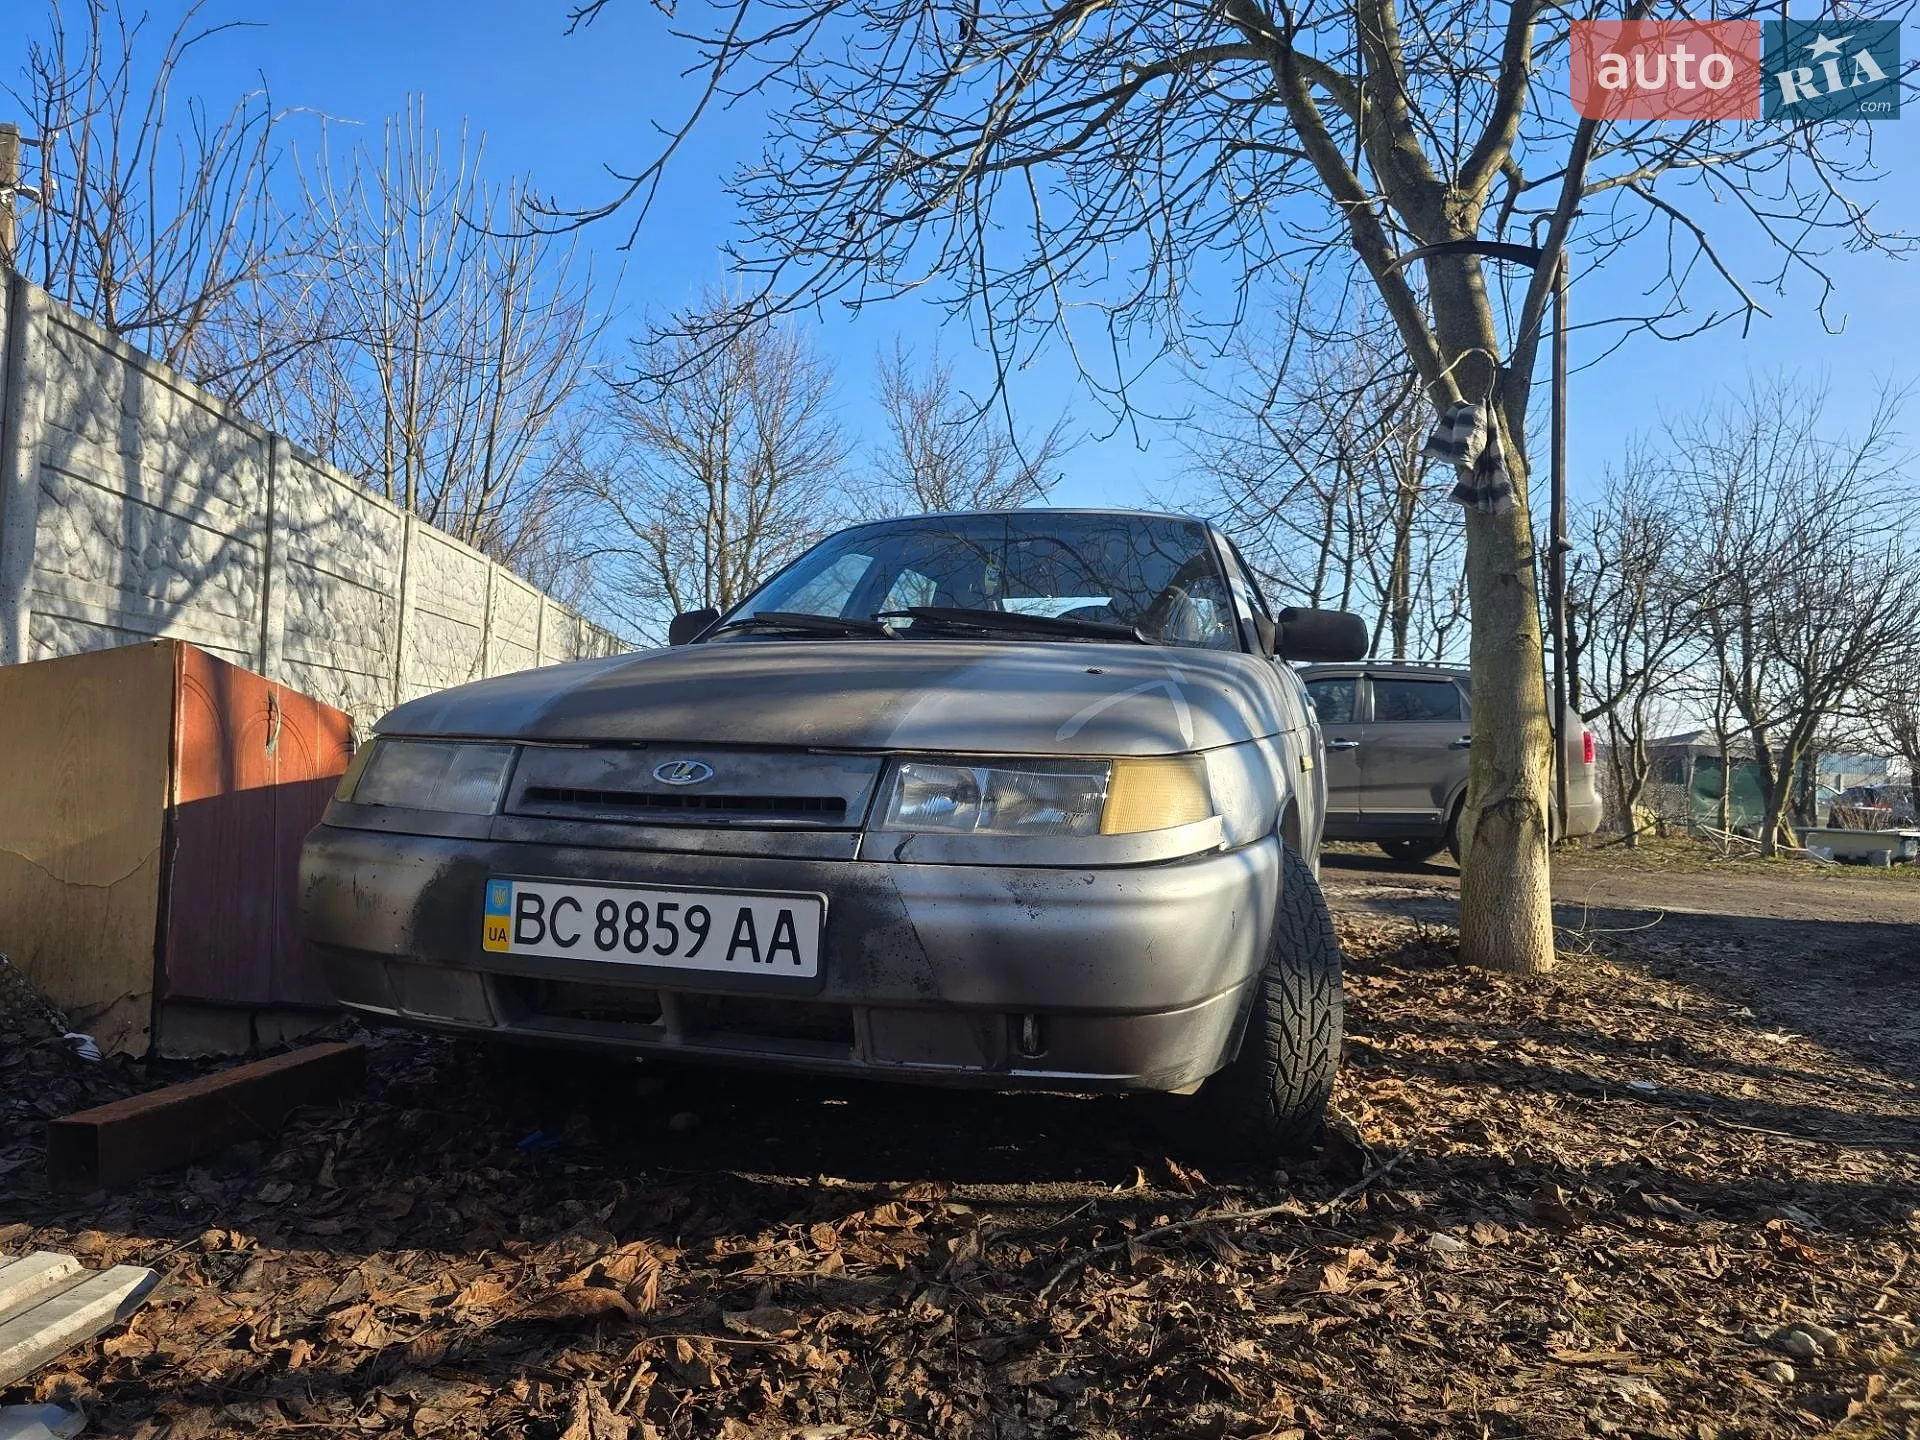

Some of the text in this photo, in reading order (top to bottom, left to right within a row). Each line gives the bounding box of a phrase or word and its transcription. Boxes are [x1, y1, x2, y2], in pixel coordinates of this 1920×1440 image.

[488, 927, 508, 943] UA
[514, 892, 802, 966] BC 8859 AA
